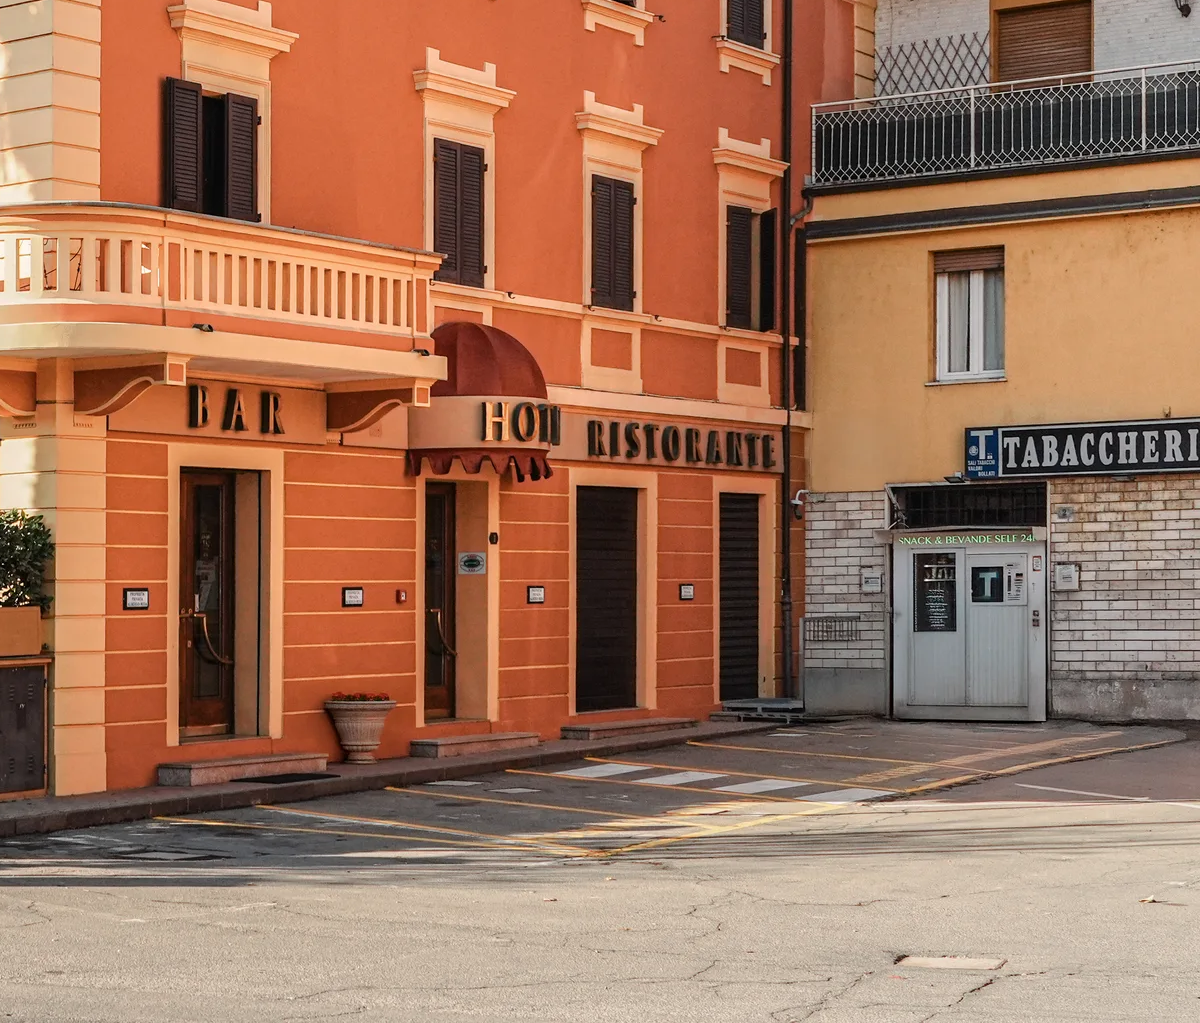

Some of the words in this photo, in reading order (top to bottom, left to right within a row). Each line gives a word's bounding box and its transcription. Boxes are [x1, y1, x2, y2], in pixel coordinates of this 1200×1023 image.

[188, 384, 285, 434] BAR
[587, 419, 777, 468] RISTORANTE
[1003, 429, 1199, 468] TABACCHERI
[899, 536, 932, 545] SNACK
[945, 535, 993, 544] BEVANDE
[995, 534, 1017, 543] SELF
